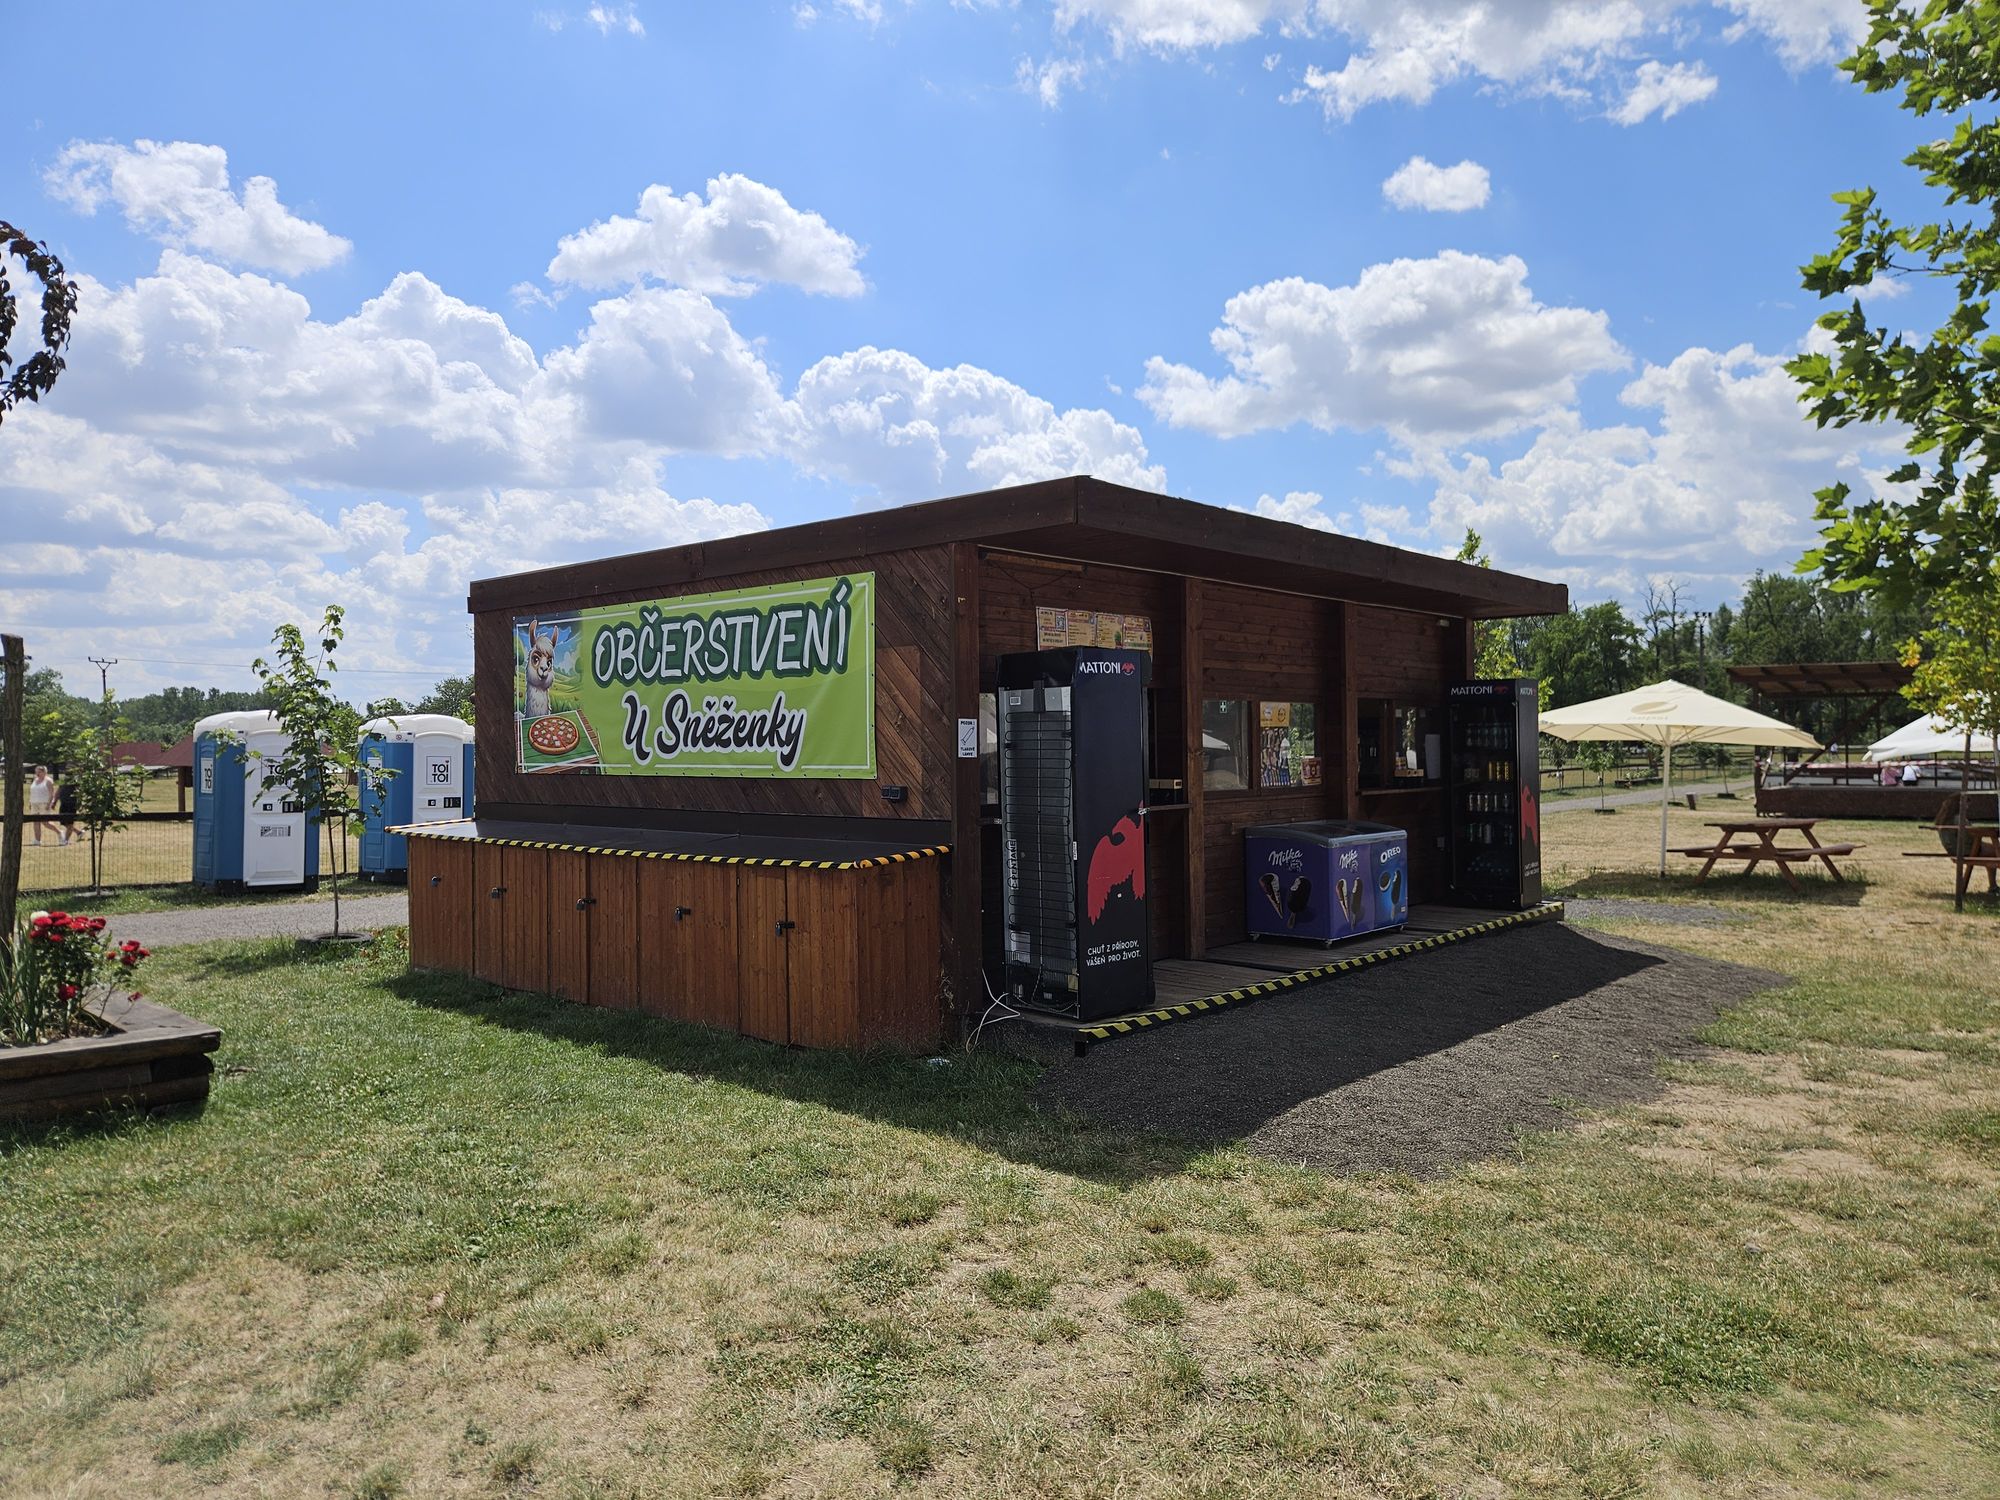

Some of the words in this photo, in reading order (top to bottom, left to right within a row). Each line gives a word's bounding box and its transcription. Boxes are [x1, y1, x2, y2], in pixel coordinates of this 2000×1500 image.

[594, 583, 849, 682] OBČERSTVENÍ
[1080, 662, 1121, 674] MATTONI
[1450, 686, 1493, 696] MATTONI
[624, 694, 651, 761] U
[656, 693, 804, 767] Sněženky
[268, 765, 285, 775] TO
[432, 773, 449, 783] TOI
[1268, 848, 1304, 866] Milka
[1380, 846, 1401, 863] OREO
[1106, 944, 1111, 953] Z
[1108, 953, 1121, 963] PRO
